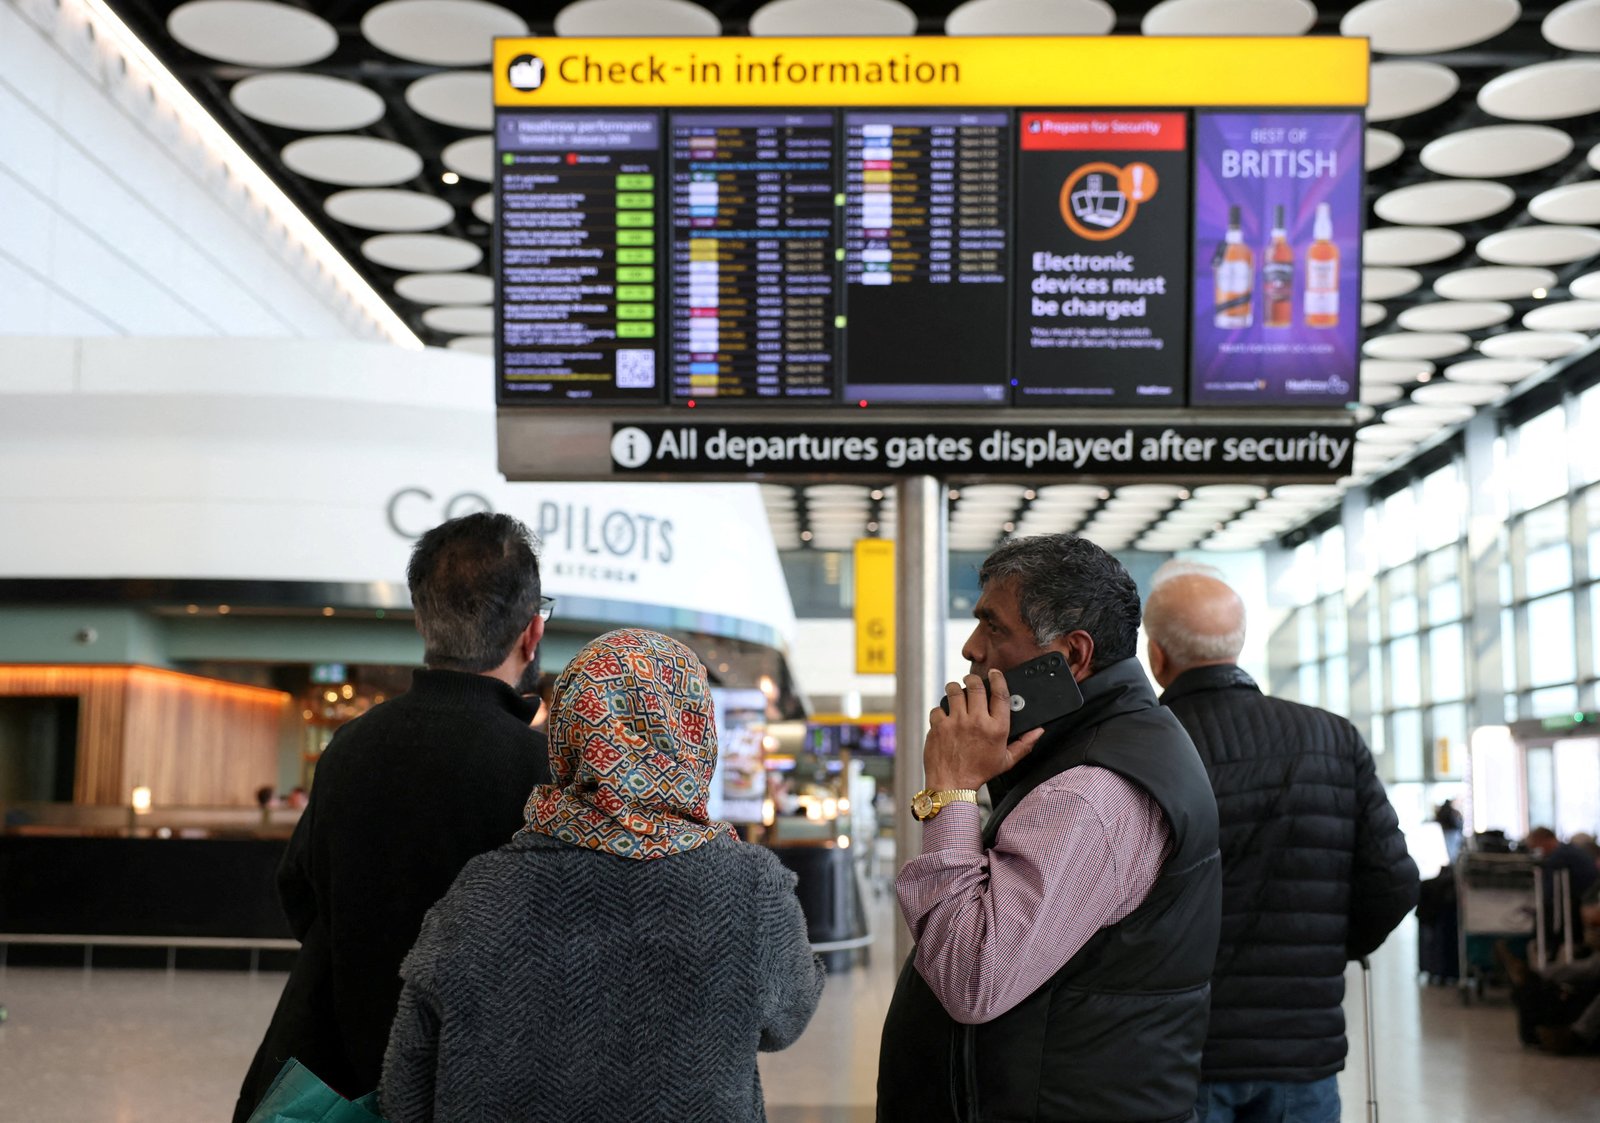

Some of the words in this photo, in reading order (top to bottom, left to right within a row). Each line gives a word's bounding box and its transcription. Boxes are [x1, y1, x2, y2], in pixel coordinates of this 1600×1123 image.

[559, 54, 721, 84] Check-in
[735, 54, 961, 84] information
[1043, 120, 1088, 135] Prepare
[1091, 119, 1108, 133] for
[1111, 119, 1161, 135] Security
[1251, 128, 1285, 144] BEST
[1288, 128, 1308, 144] OF
[1221, 149, 1338, 178] BRITISH
[1032, 251, 1134, 272] Electronic
[1031, 273, 1109, 294] devices
[1112, 275, 1166, 294] must
[1031, 296, 1059, 316] be
[1061, 296, 1146, 321] charged
[656, 427, 697, 460] All
[705, 428, 879, 467] departures
[885, 433, 973, 468] gates
[979, 429, 1133, 468] displayed
[1140, 429, 1217, 461] after
[1222, 431, 1350, 468] security
[540, 501, 673, 563] PILOTS
